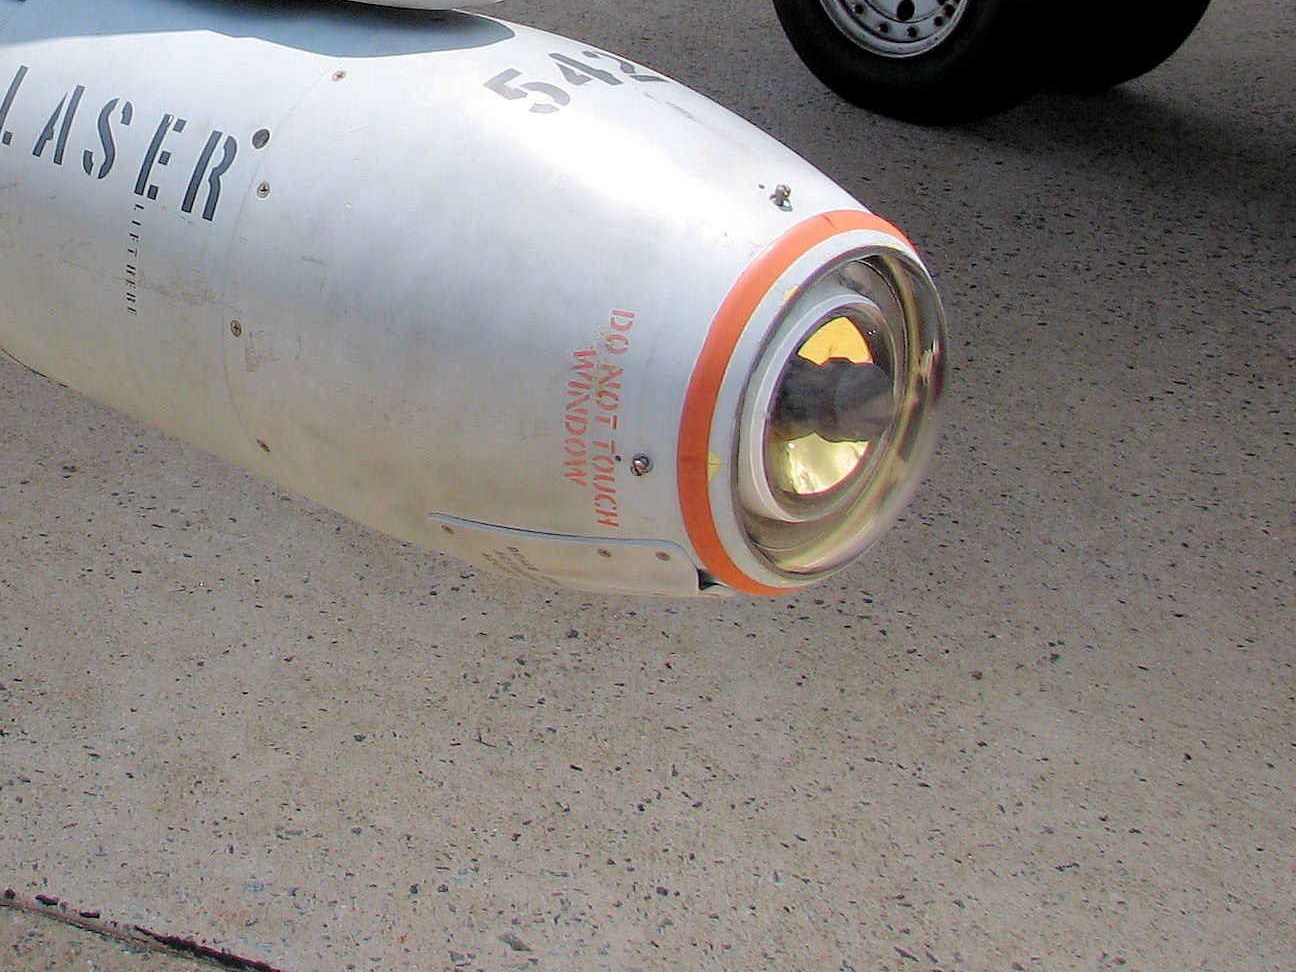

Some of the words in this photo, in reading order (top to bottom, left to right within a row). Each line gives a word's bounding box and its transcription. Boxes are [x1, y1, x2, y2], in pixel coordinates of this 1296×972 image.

[483, 50, 671, 114] 542
[127, 203, 145, 259] LIFT
[126, 264, 137, 317] HERE
[605, 309, 635, 354] DO
[563, 349, 598, 488] WINDOW
[596, 362, 624, 430] NOT
[592, 439, 621, 527] TOUCH
